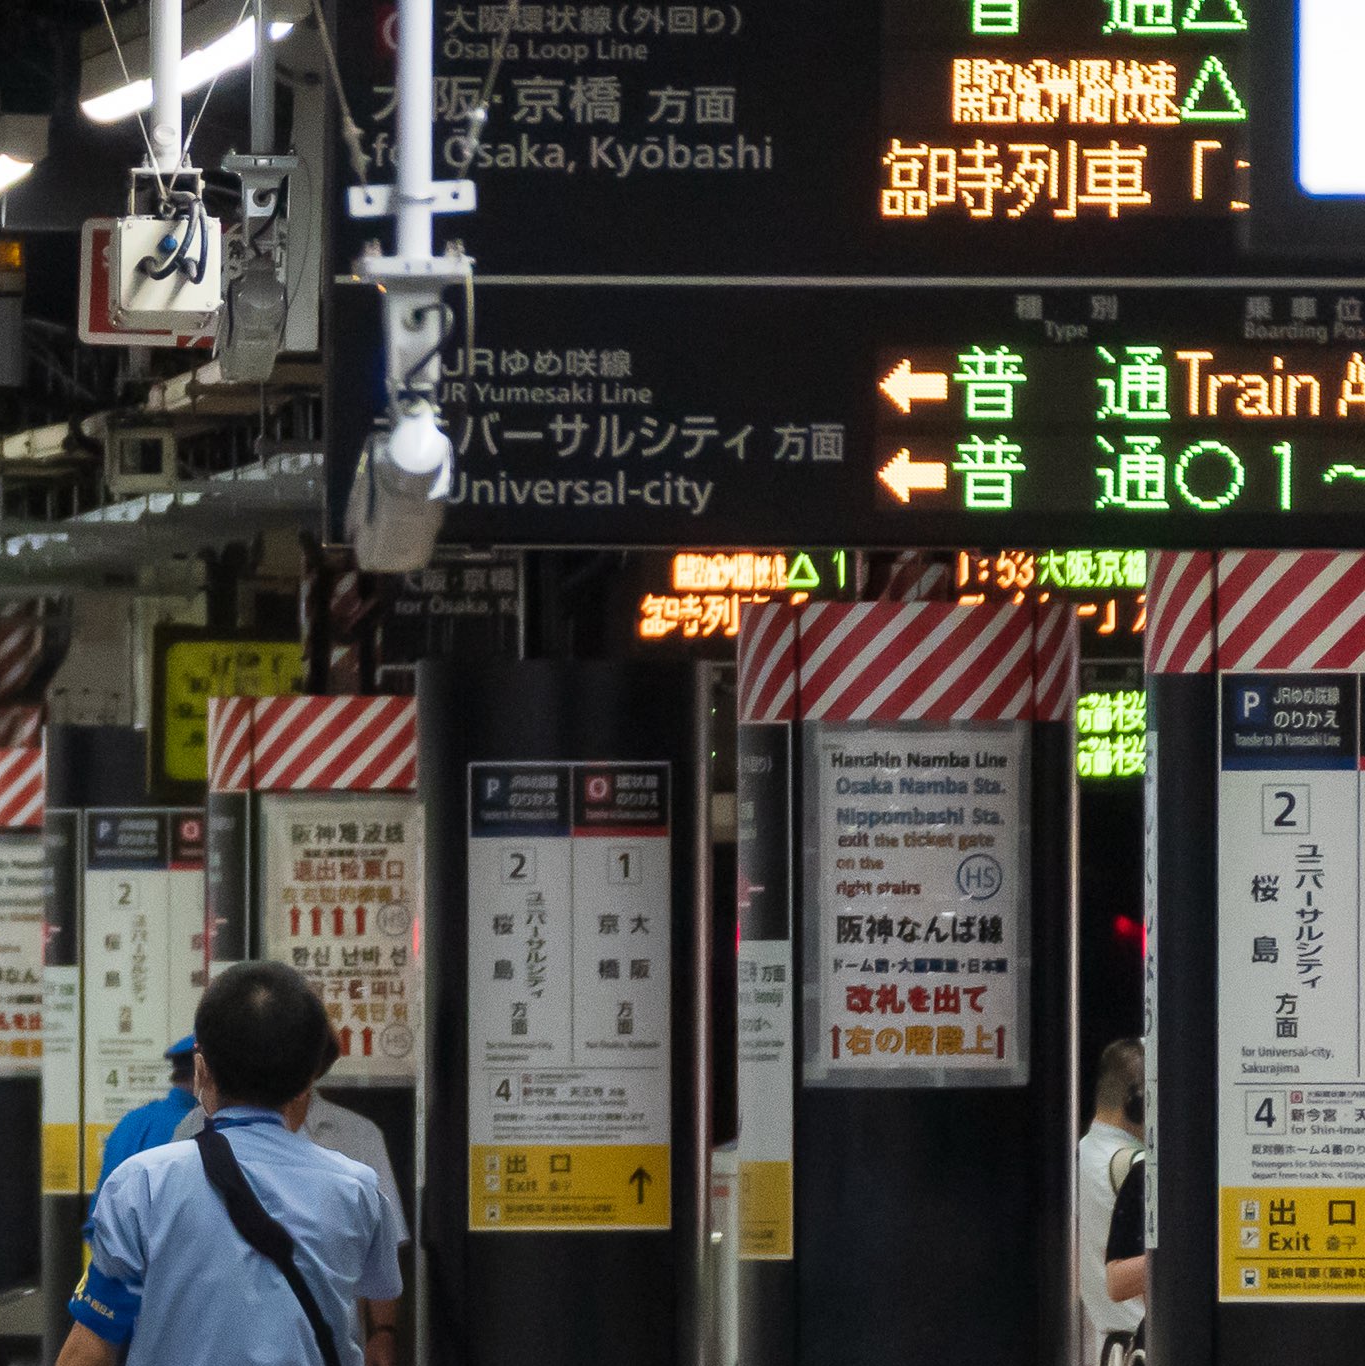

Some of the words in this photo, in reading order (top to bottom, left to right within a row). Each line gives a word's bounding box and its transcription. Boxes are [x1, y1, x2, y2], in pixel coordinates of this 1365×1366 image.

[528, 40, 590, 63] Loop
[603, 39, 649, 61] Line
[649, 85, 737, 125] 方面
[590, 135, 773, 178] Kyōbashi
[1044, 320, 1089, 342] Type
[1244, 321, 1328, 344] Boarding
[441, 348, 633, 379] JRゆめ咲線
[438, 383, 467, 404] JR
[474, 382, 595, 405] Yumesaki
[601, 383, 653, 404] Line
[953, 345, 1171, 421] 普通
[1175, 350, 1321, 417] Train
[774, 423, 846, 462] 方面
[952, 435, 1170, 511] 普通
[1243, 690, 1261, 718] P
[1273, 709, 1340, 729] のりかえ
[831, 751, 902, 769] Hanshin
[906, 751, 971, 769] Namba
[835, 776, 894, 796] Osaka
[899, 776, 969, 796] Namba
[973, 777, 1007, 796] Sta.
[1273, 790, 1298, 828] 2
[837, 831, 870, 848] exit
[874, 832, 900, 849] the
[903, 831, 955, 849] ticket
[957, 832, 996, 852] gate
[509, 852, 528, 879] 2
[618, 852, 630, 879] 1
[835, 857, 855, 870] on
[858, 855, 885, 871] the
[118, 882, 133, 906] 2
[835, 878, 873, 899] right
[876, 879, 922, 896] stairs
[836, 914, 1004, 945] 阪神なんば線
[1250, 874, 1280, 965] 桜島
[1295, 844, 1324, 989] ユニバーサルシティ
[844, 983, 989, 1016] 改札を出て
[1275, 992, 1299, 1039] 方面
[1241, 1046, 1255, 1057] for
[1241, 1062, 1301, 1076] Sakurajima
[495, 1078, 512, 1103] 4
[1254, 1096, 1277, 1129] 4
[1291, 1124, 1307, 1136] for
[506, 1153, 572, 1174] 出口
[506, 1177, 539, 1193] Exit
[1269, 1198, 1356, 1226] 出口
[1268, 1231, 1311, 1251] Exit
